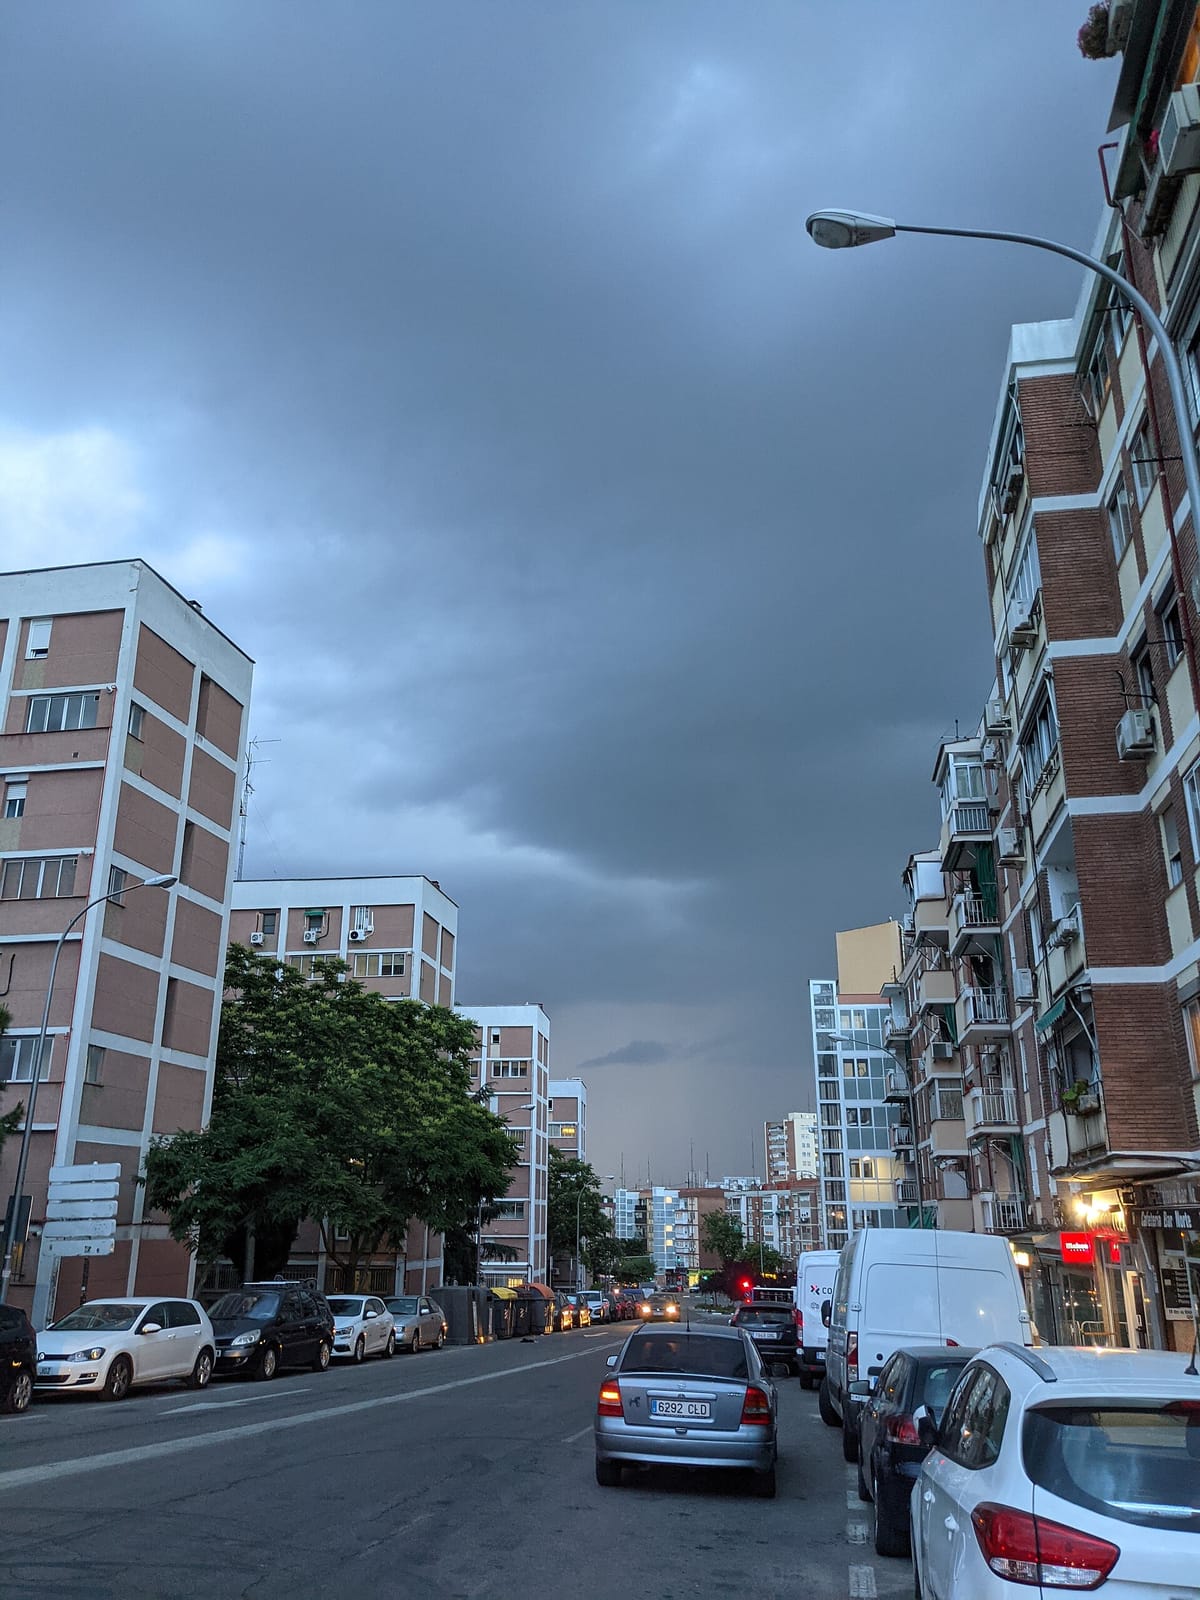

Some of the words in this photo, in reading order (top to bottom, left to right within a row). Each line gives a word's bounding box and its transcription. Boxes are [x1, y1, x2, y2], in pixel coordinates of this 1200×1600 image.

[1163, 1210, 1173, 1228] Bar
[1174, 1210, 1193, 1229] Norte
[658, 1402, 683, 1414] 6292
[687, 1403, 707, 1415] CLD
